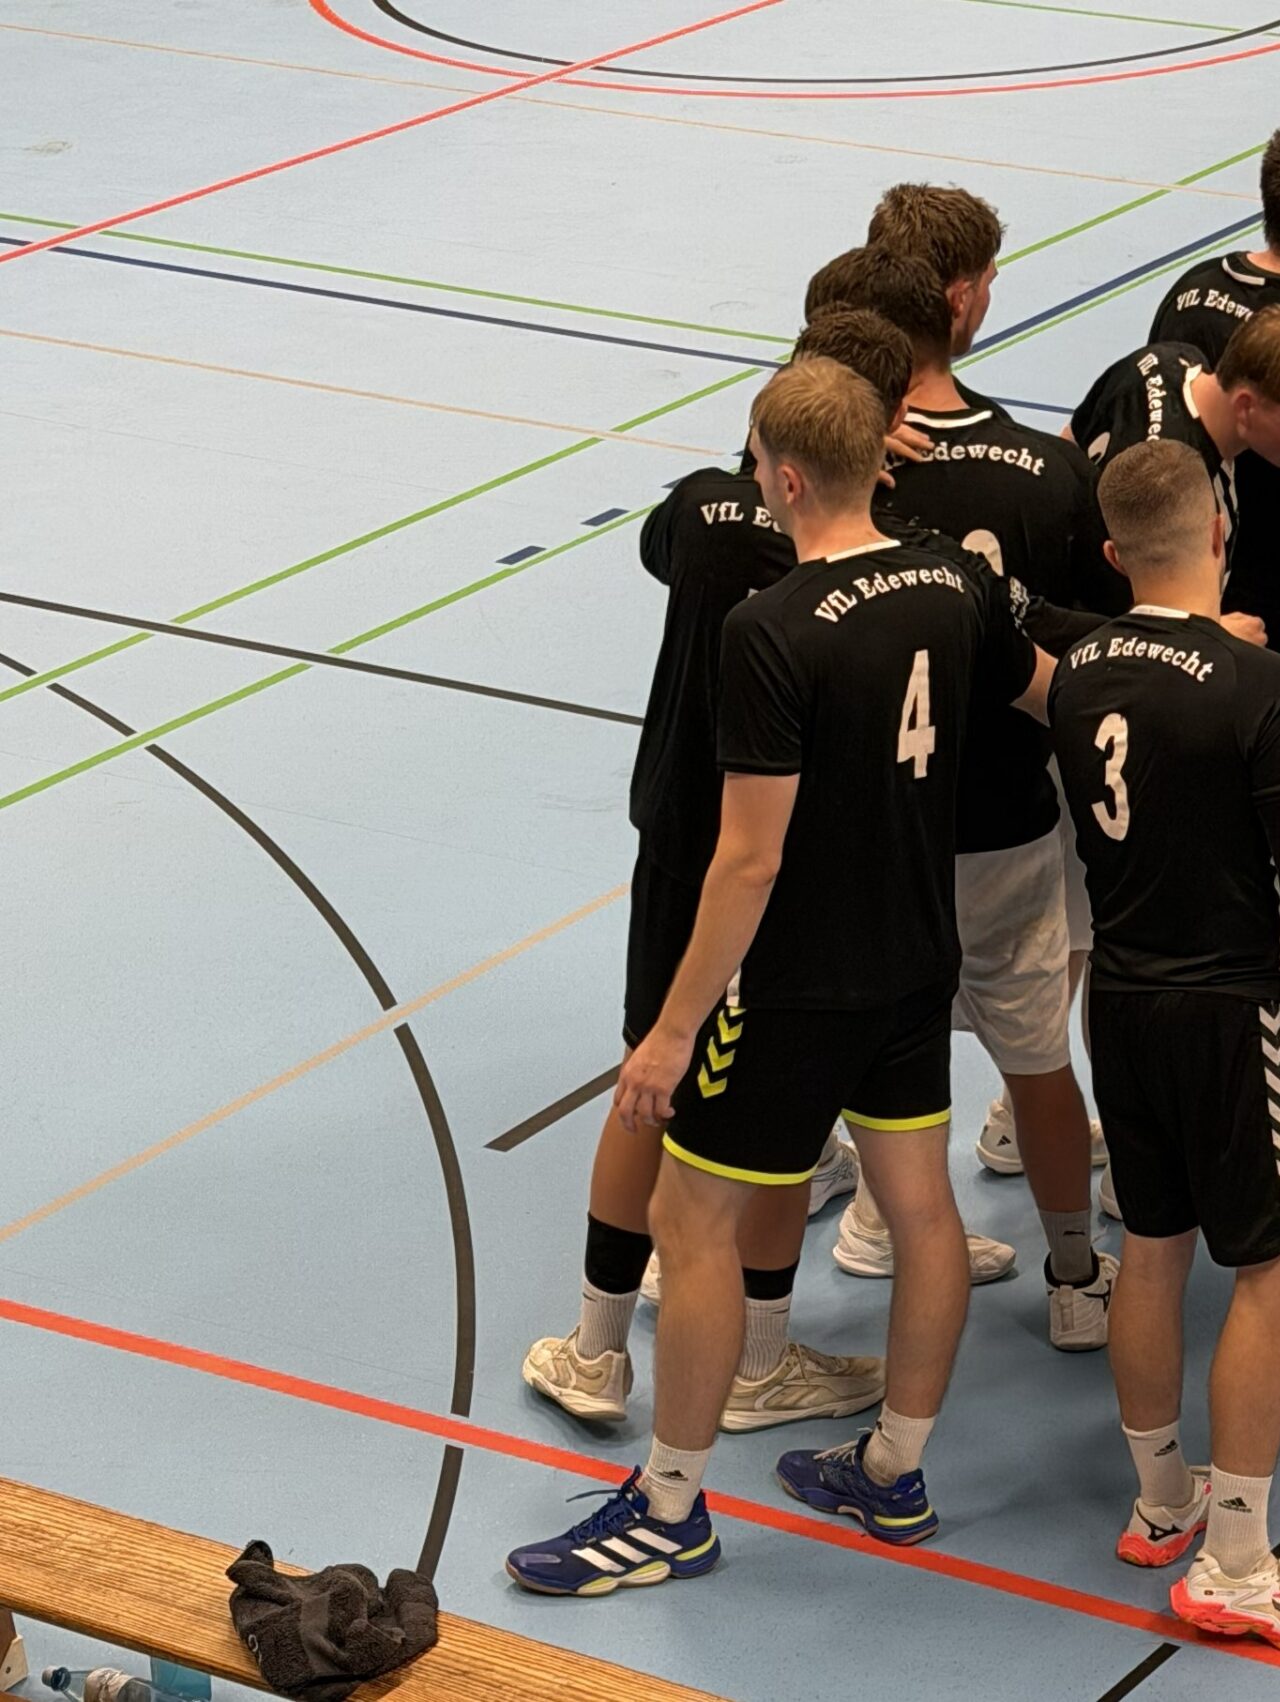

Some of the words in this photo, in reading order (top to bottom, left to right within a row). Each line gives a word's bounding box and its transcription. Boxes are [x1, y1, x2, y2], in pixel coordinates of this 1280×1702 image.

[700, 501, 745, 525] VfL
[814, 589, 858, 623] VfL
[853, 566, 965, 600] Edewecht
[1070, 641, 1101, 670] VfL
[1106, 636, 1214, 682] Edewecht
[897, 649, 936, 778] 4
[1091, 712, 1131, 841] 3
